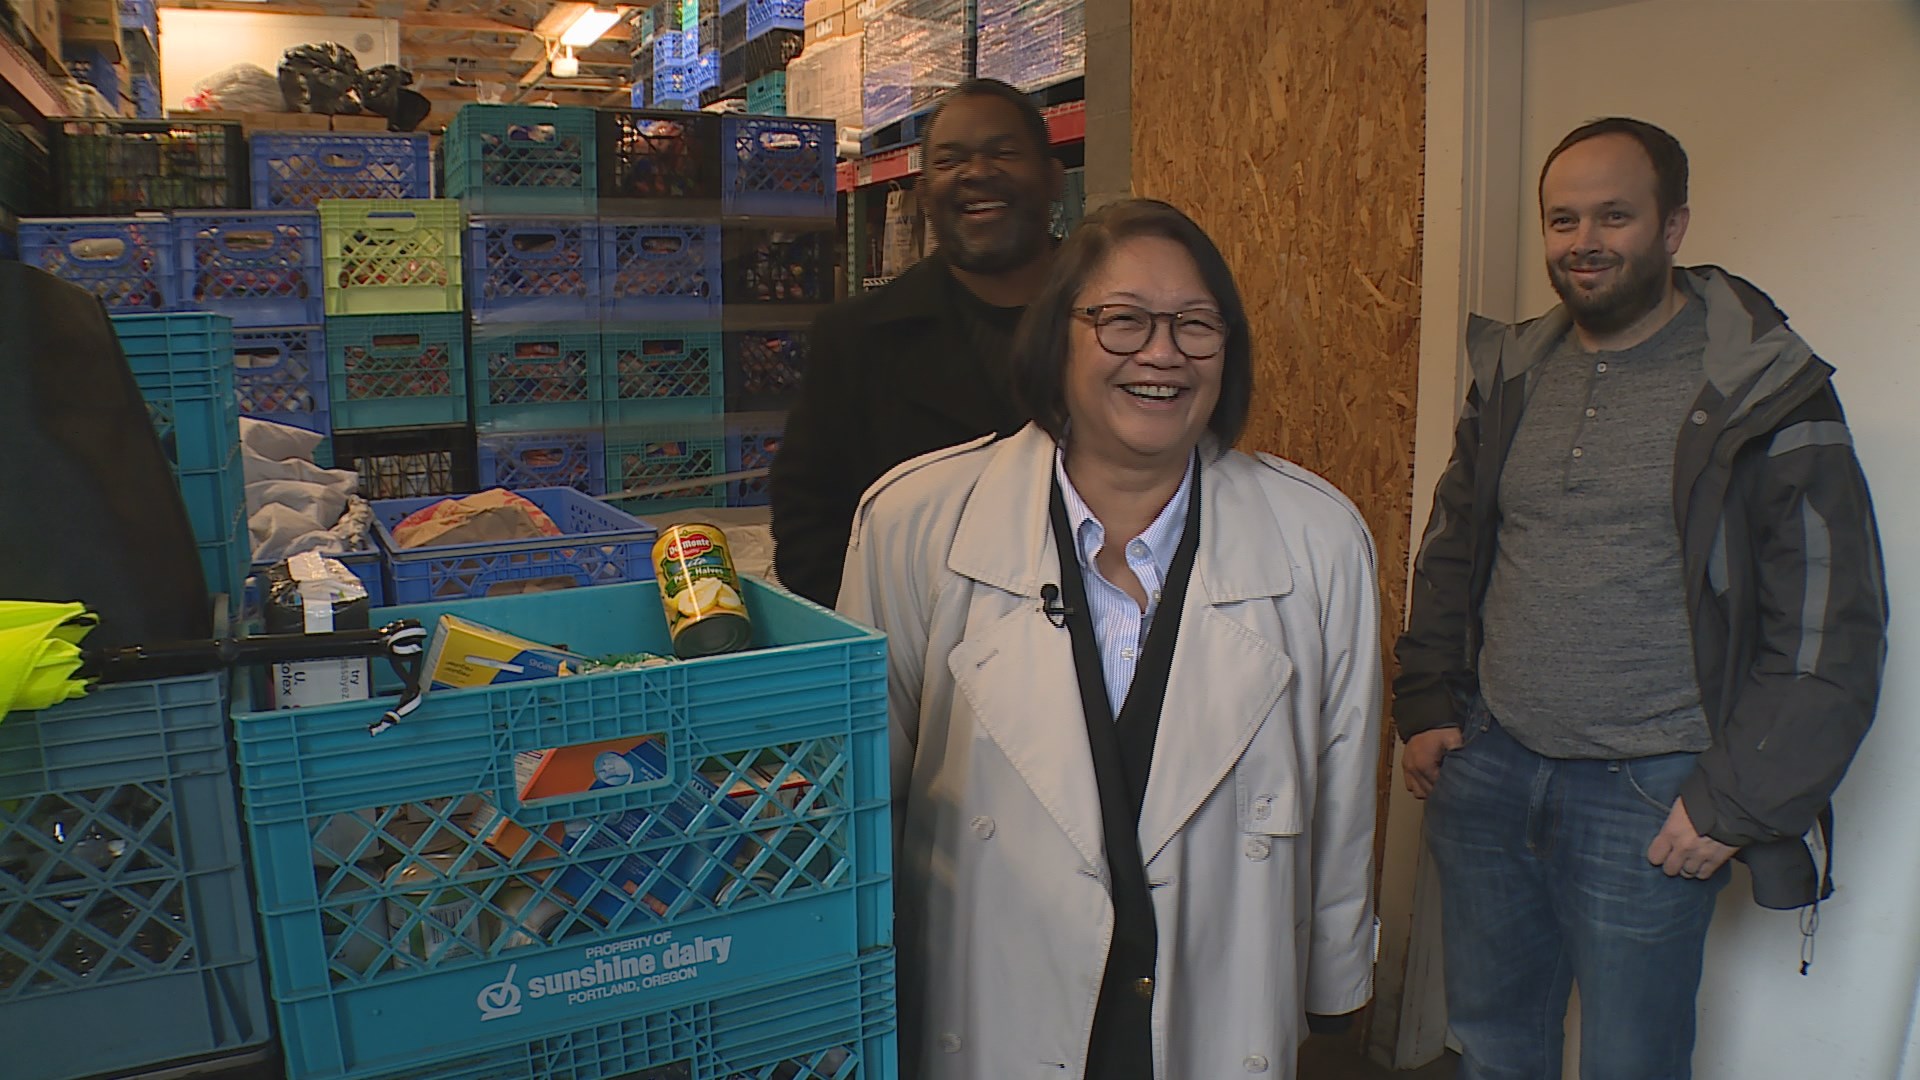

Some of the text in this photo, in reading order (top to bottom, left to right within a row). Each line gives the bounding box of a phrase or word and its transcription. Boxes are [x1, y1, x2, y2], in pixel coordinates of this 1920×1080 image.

[682, 538, 710, 549] Monte
[695, 566, 724, 575] Halves
[350, 669, 360, 685] try
[585, 931, 672, 959] PROPERTY OF
[527, 935, 732, 998] sunshine dairy
[568, 966, 698, 1005] PORTLAND, OREGON
